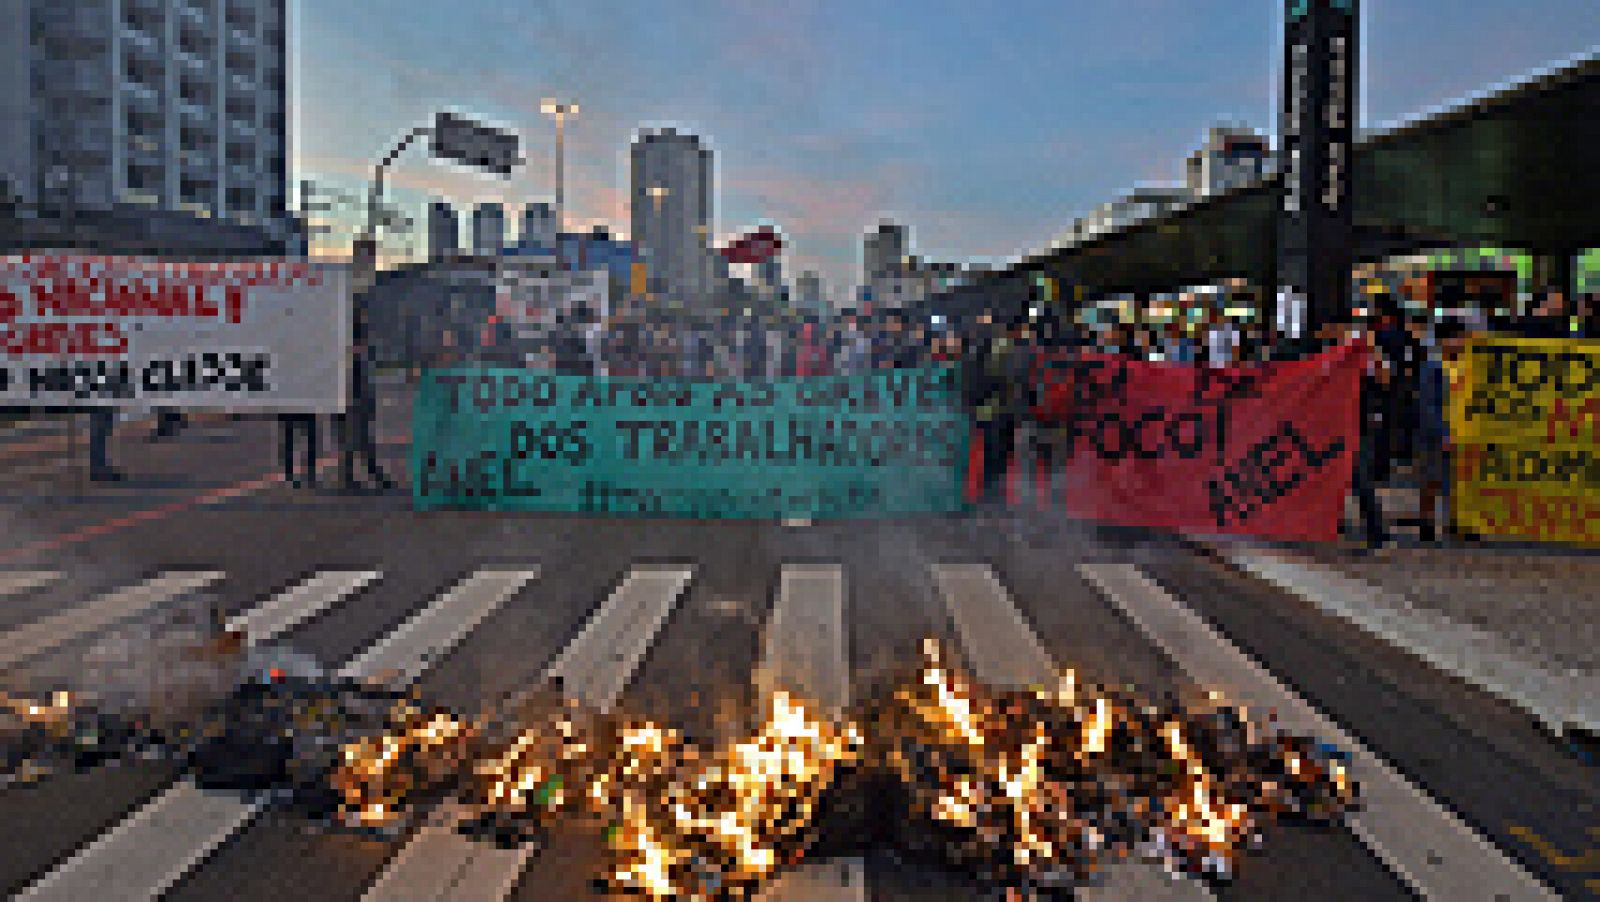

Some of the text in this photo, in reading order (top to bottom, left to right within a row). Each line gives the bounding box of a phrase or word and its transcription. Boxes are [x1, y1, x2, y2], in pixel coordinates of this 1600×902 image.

[436, 374, 557, 413] TODO
[510, 420, 588, 464] DOS
[419, 449, 541, 498] ANEL
